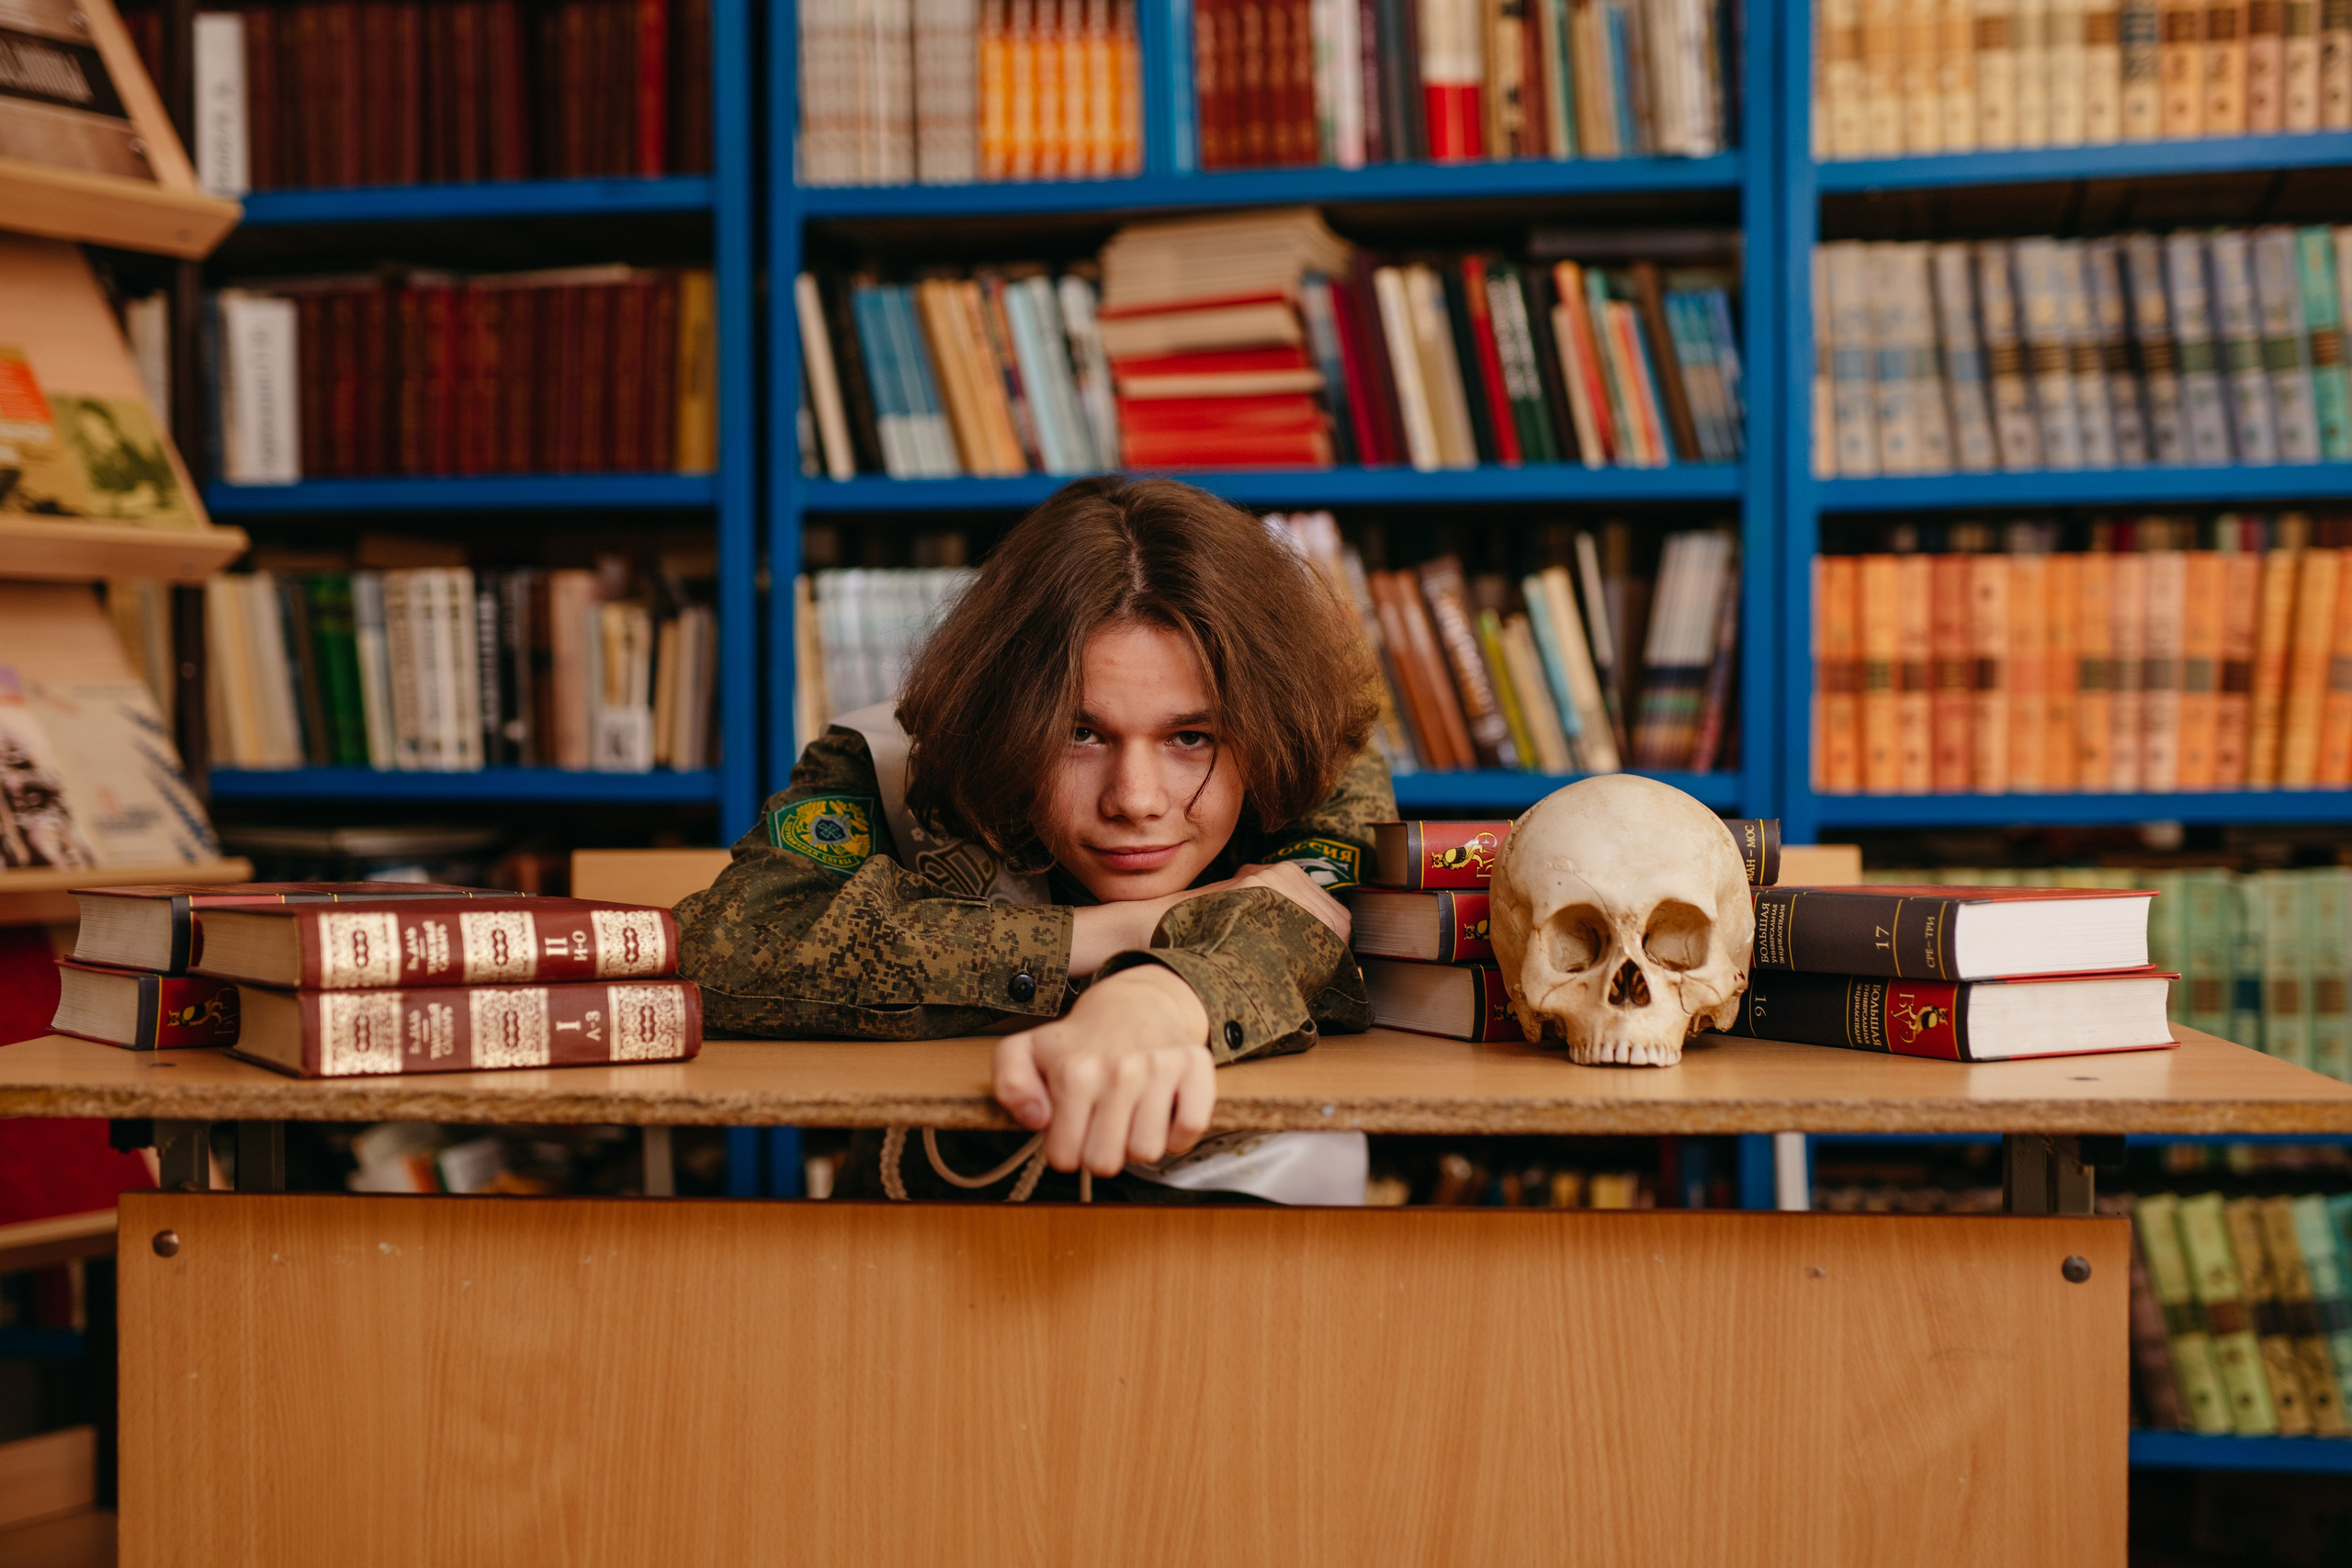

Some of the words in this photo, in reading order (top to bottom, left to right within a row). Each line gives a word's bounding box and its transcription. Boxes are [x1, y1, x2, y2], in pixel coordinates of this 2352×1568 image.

[1745, 824, 1756, 848] МОС
[1758, 902, 1770, 964] БОЛЬШАЯ
[1770, 904, 1779, 964] УНИВЕРСАЛЬНАЯ
[1777, 904, 1786, 964] ЭНЦИКЛОПЕДИЯ
[1875, 925, 1890, 950] 17
[1754, 995, 1767, 1017] 16
[1870, 983, 1883, 1046] БОЛЬШАЯ
